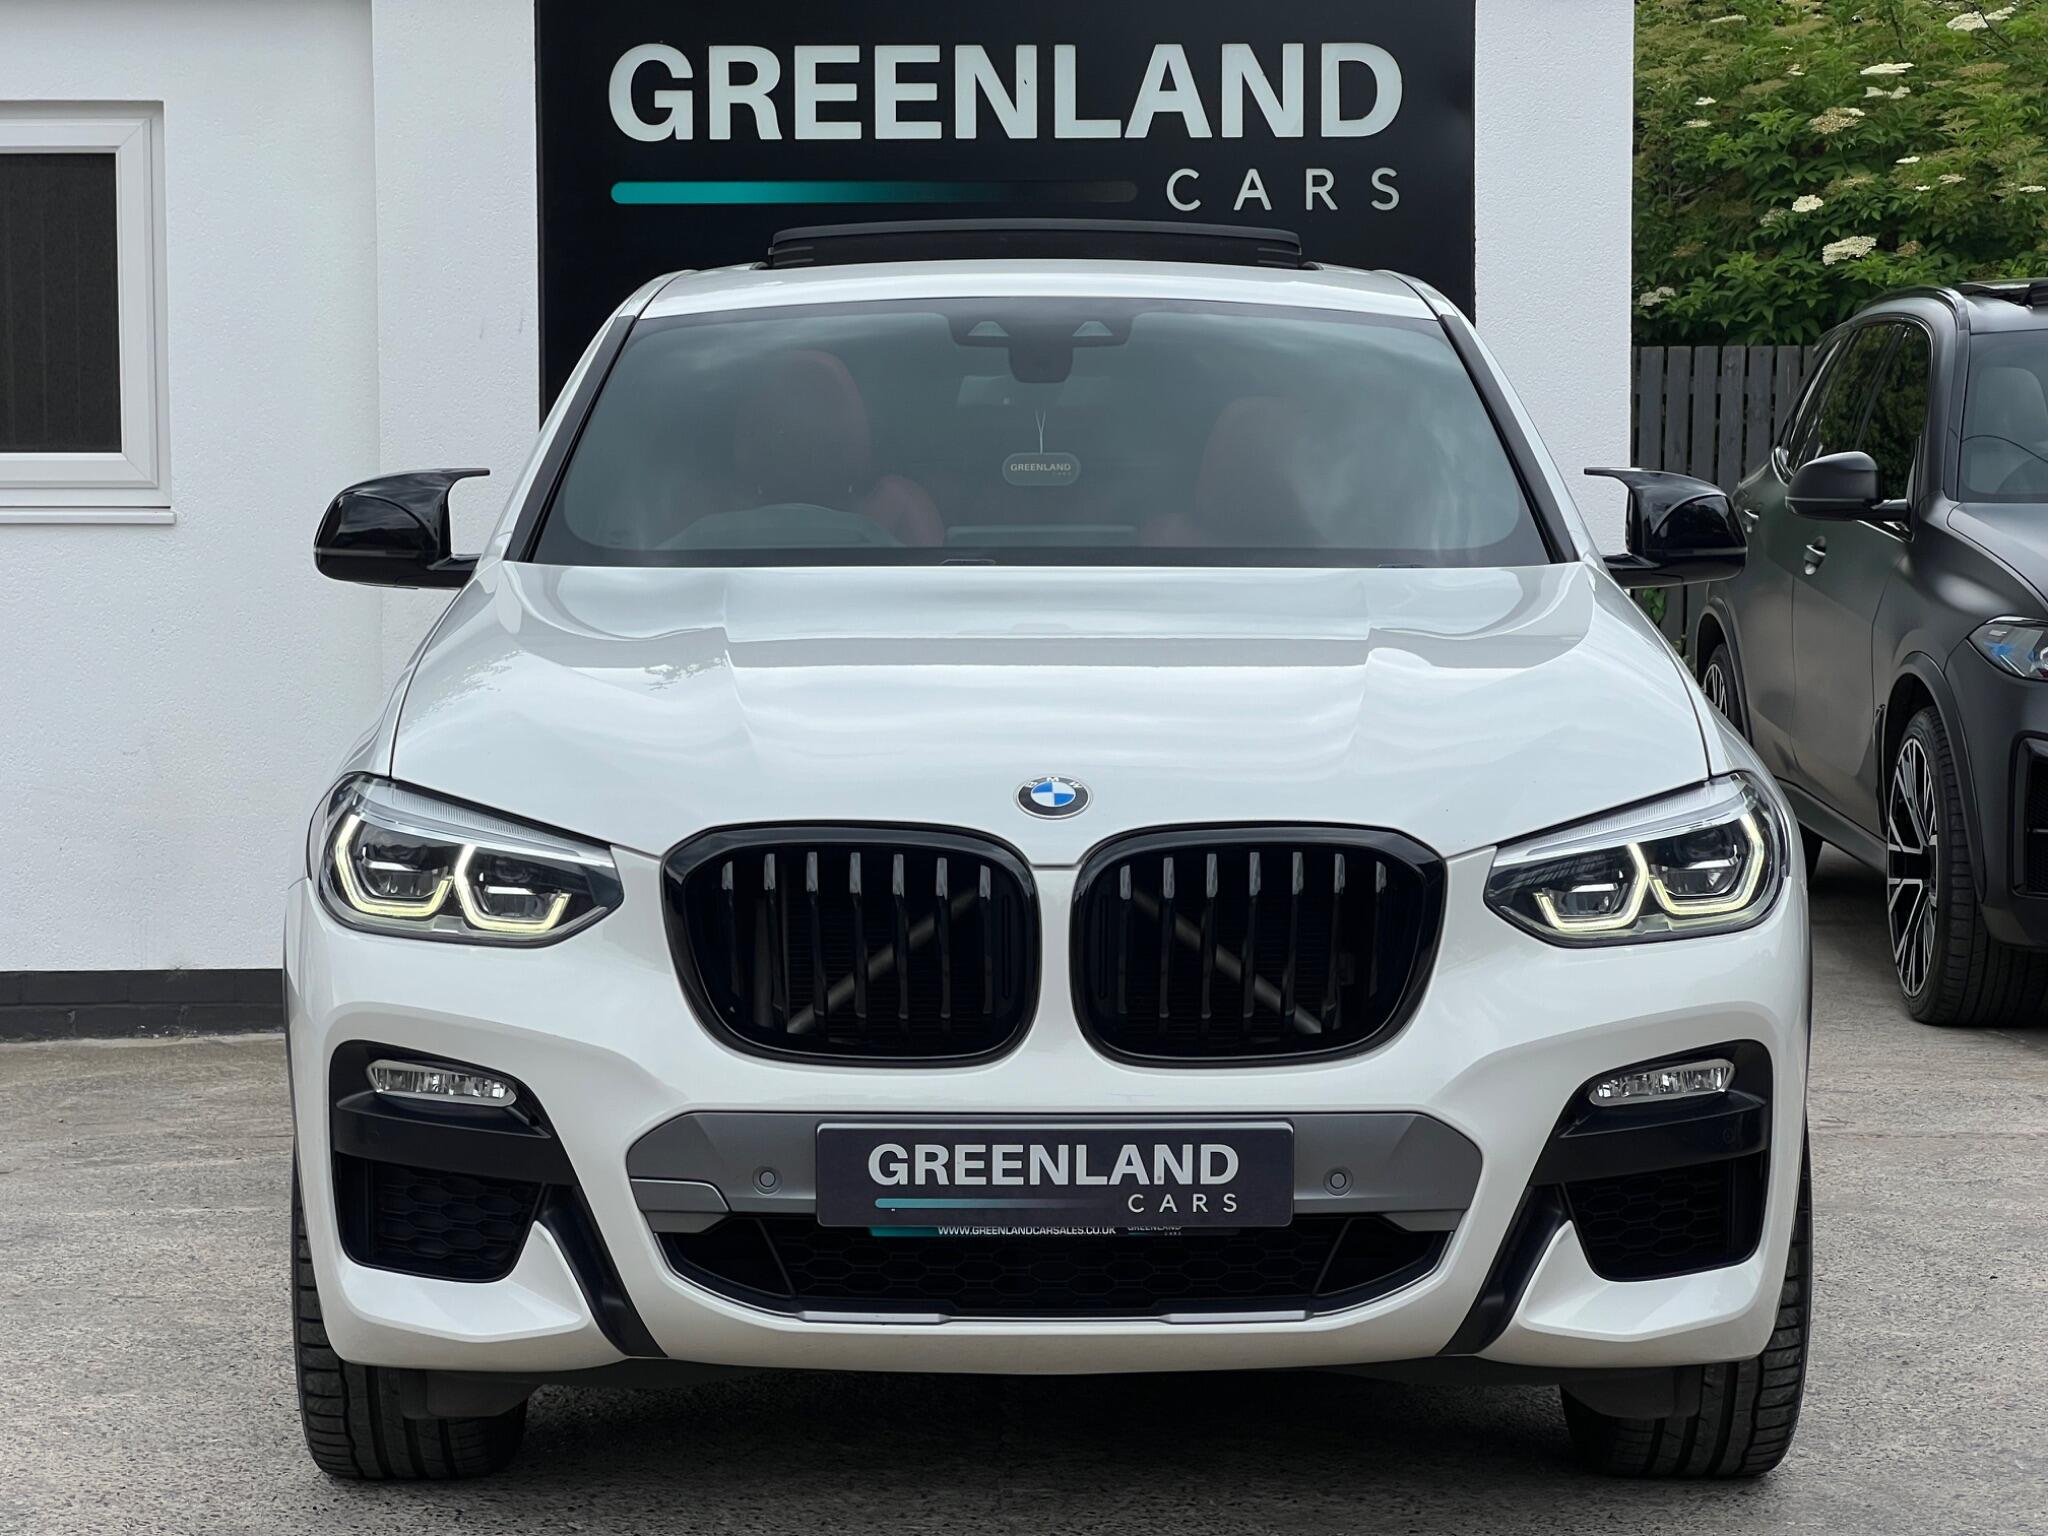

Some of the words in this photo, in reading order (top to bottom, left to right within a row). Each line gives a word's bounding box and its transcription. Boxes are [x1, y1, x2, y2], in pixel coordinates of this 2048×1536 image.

[609, 43, 1402, 141] GREENLAND
[1166, 168, 1400, 210] CARS
[1010, 463, 1071, 471] GREENLAND
[868, 1143, 1239, 1186] GREENLAND
[1127, 1193, 1237, 1213] CARS
[937, 1225, 1117, 1236] WWW.GREENLANDCARSALES.CO.UK
